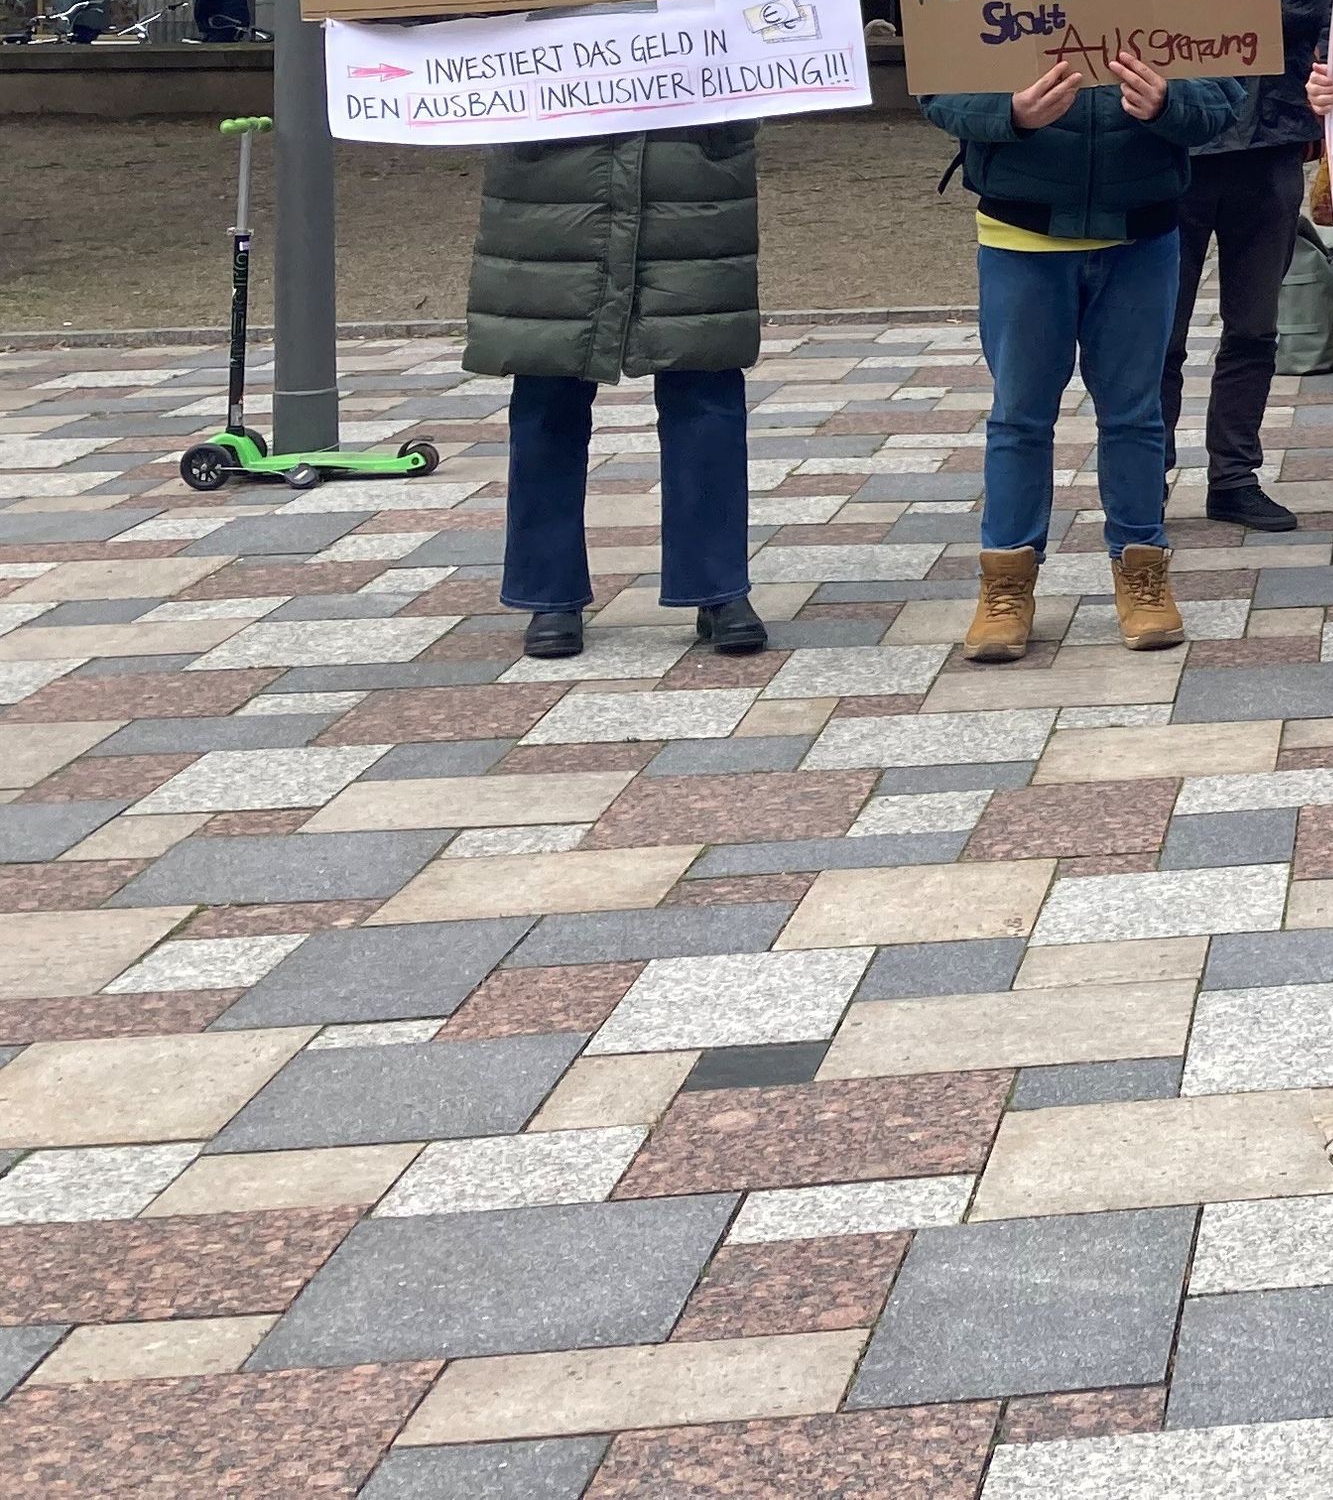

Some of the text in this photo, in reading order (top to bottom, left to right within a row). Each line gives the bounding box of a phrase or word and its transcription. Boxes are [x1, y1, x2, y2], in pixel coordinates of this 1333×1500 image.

[979, 1, 1067, 45] Statt
[425, 28, 729, 84] INVESTIERT DAS GELD IN
[346, 51, 850, 120] DEN AUSBAU INKLUSIVER BILDUNG!!!
